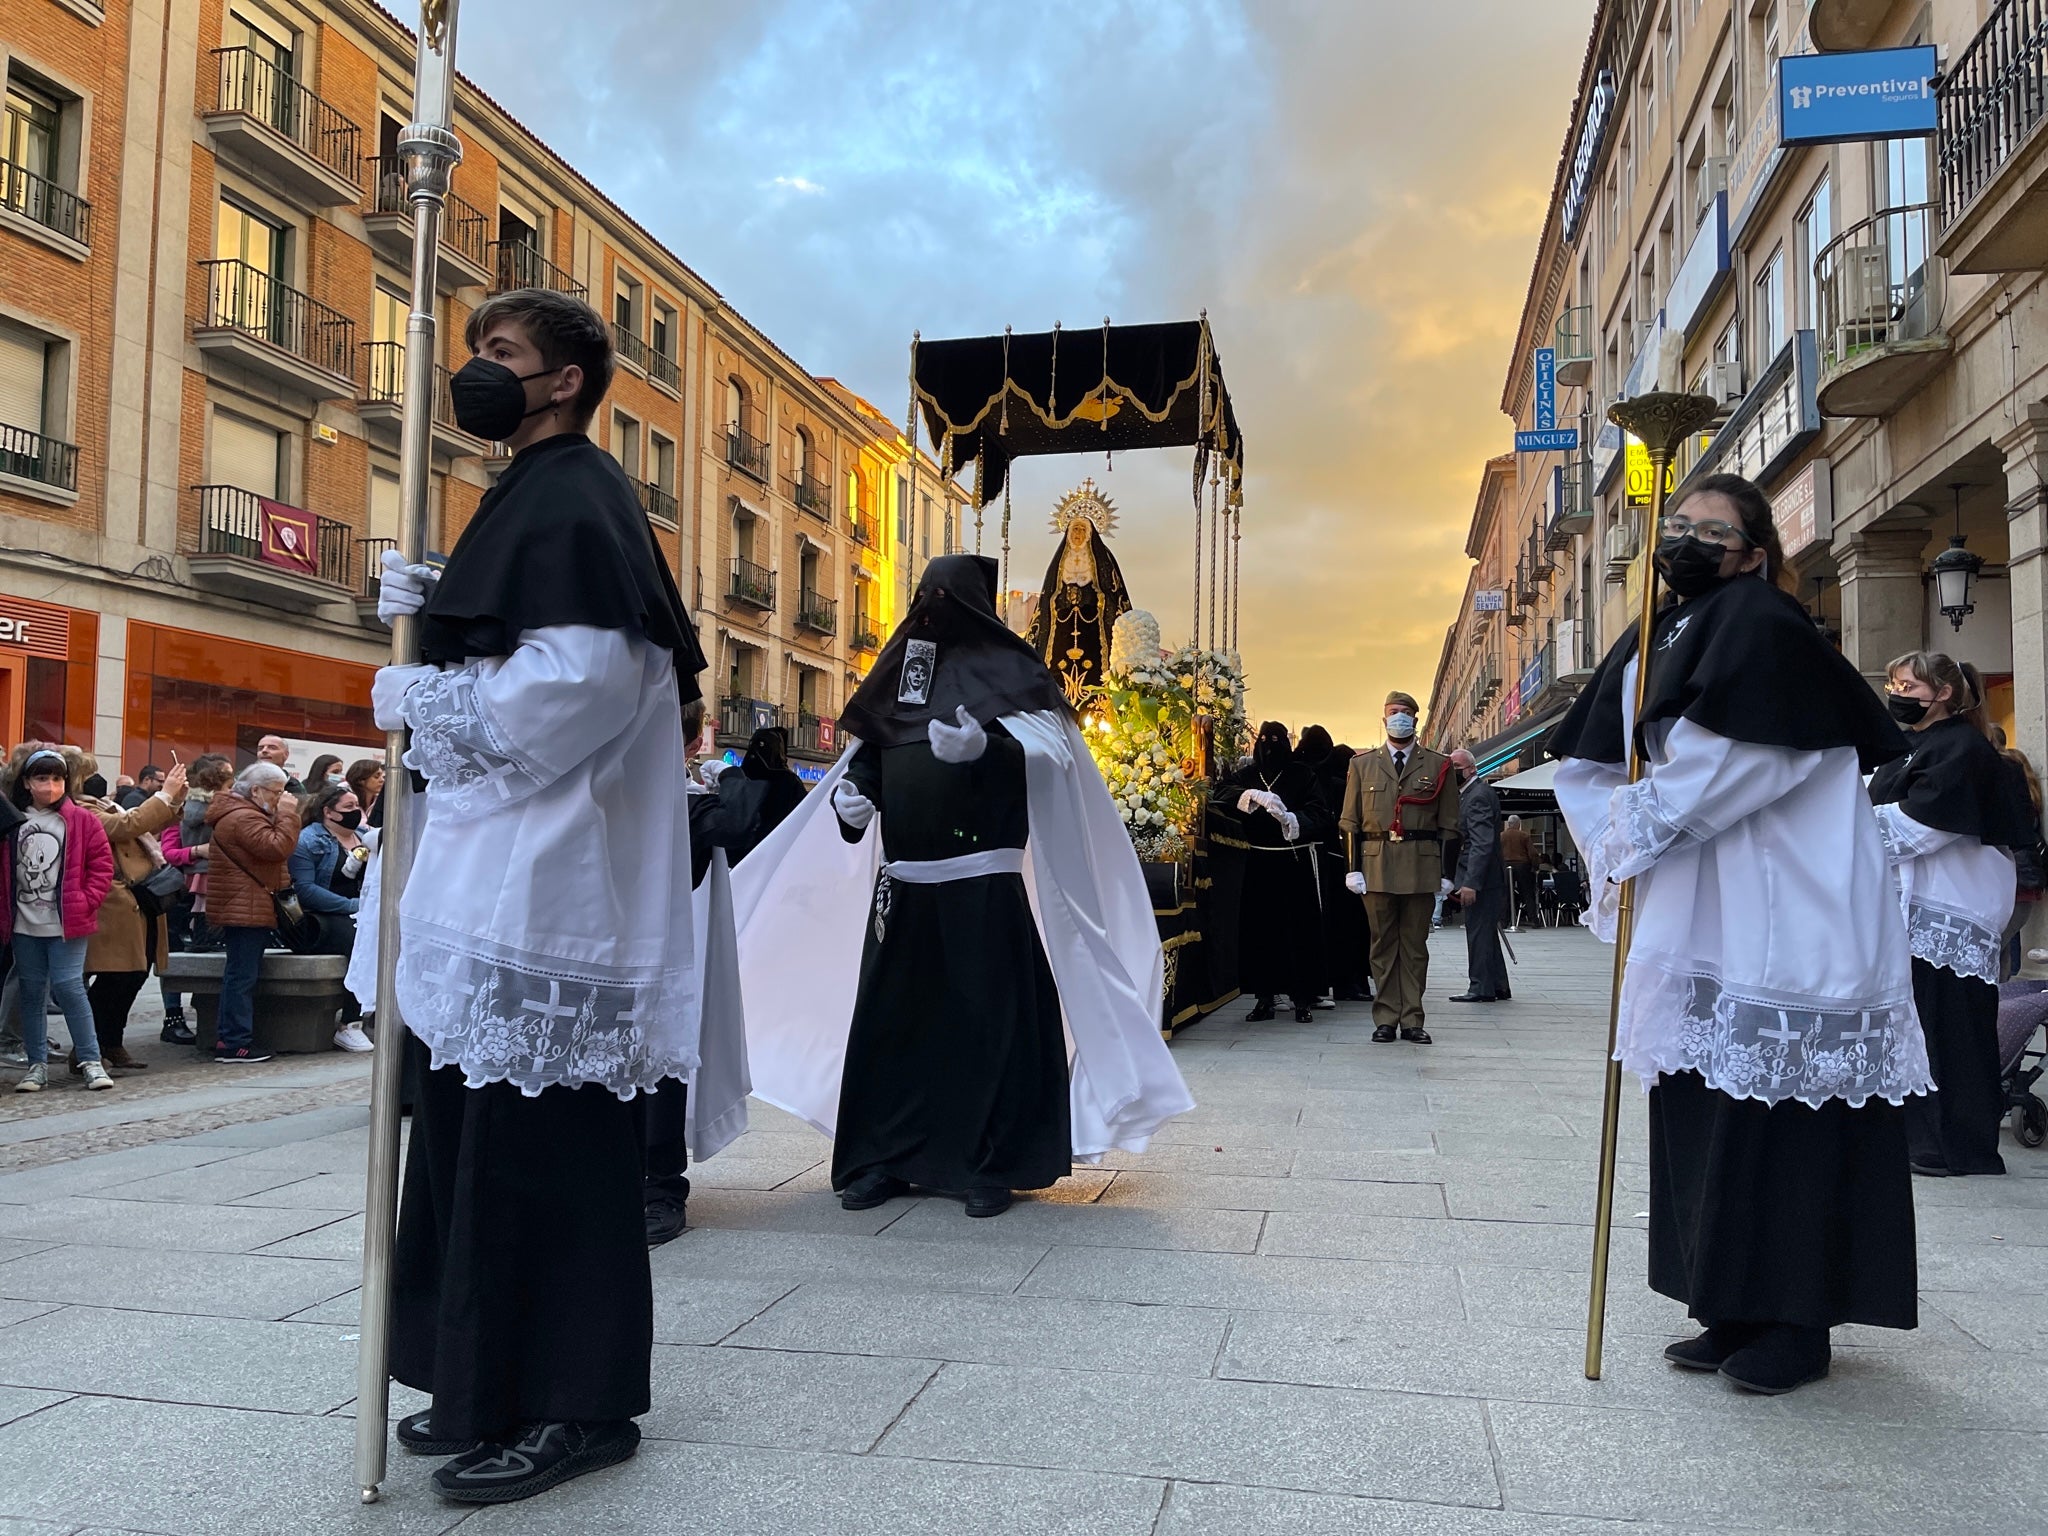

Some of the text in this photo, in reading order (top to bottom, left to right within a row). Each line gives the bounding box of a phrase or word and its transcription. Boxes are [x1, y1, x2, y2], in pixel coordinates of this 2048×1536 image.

[1815, 78, 1919, 99] Preventiva
[1881, 93, 1919, 103] Seguros
[1574, 69, 1606, 197] SEGUROS
[1538, 352, 1552, 429] OFICINAS
[1517, 433, 1575, 446] MINGUEZ
[1635, 496, 1651, 505] PIS
[1476, 595, 1502, 603] CLINICA
[1476, 602, 1502, 610] DENTAL
